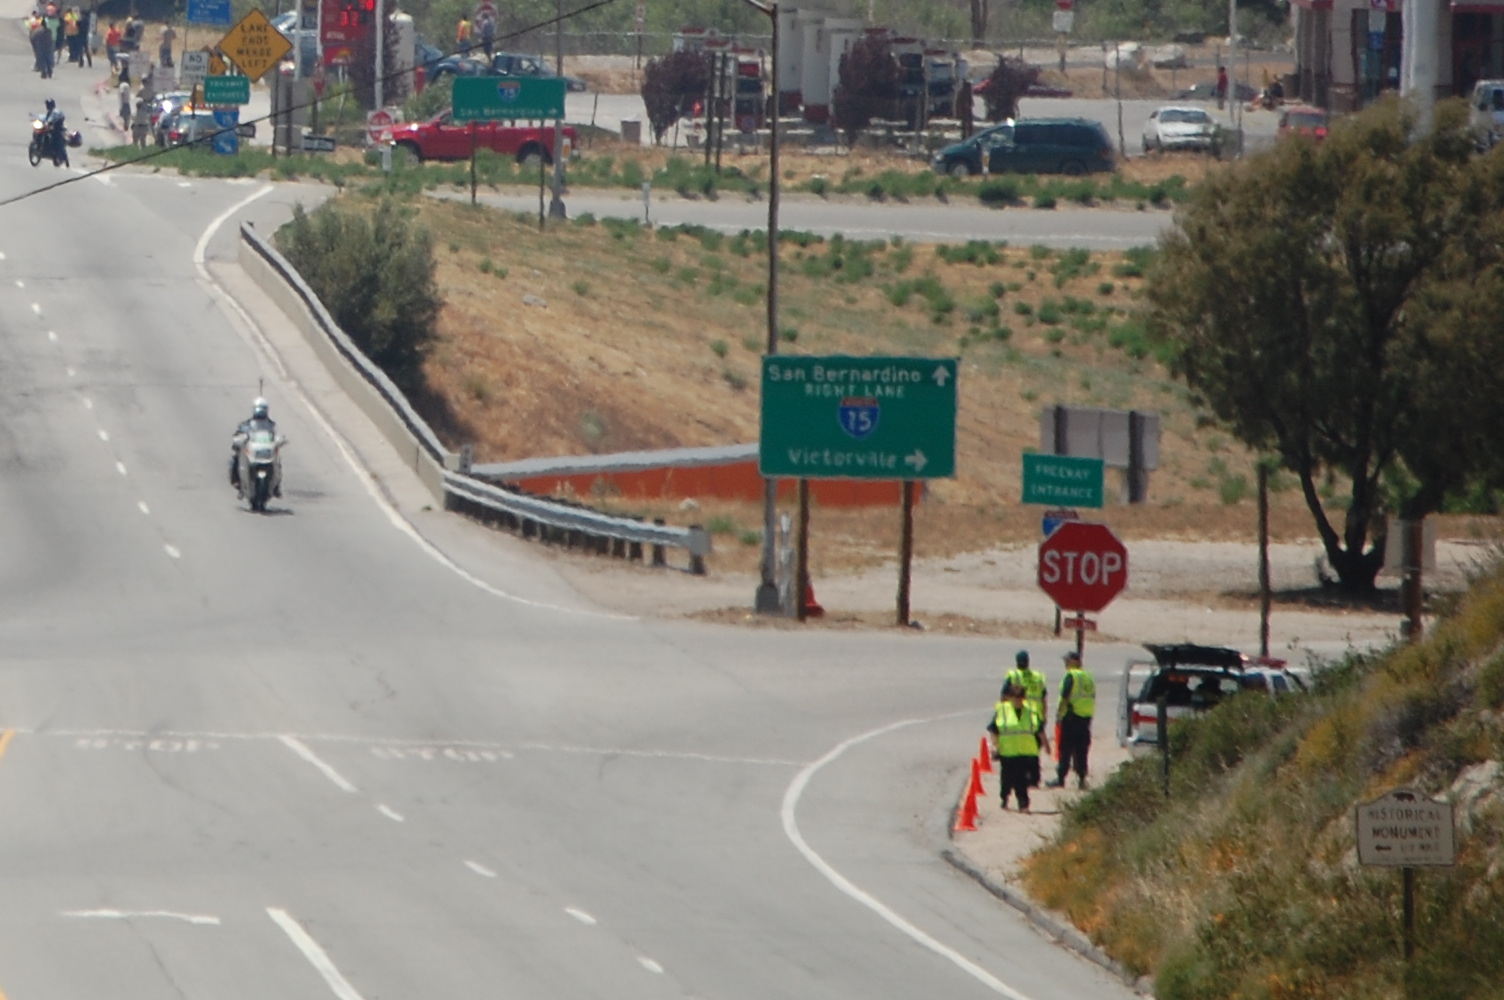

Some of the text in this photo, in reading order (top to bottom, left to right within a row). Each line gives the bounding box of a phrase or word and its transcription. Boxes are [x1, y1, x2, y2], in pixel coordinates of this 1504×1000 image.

[241, 23, 268, 33] LANE
[241, 35, 268, 44] ENDS
[236, 48, 272, 57] MERGE
[242, 59, 268, 68] LEFT
[768, 363, 921, 383] San Bernardino
[804, 383, 905, 398] RIGHT LANE
[848, 410, 872, 432] 15
[787, 448, 897, 469] Victorville
[1035, 465, 1091, 481] FREEWAY
[1030, 483, 1094, 499] ENTRANCE
[1042, 549, 1122, 586] STOP
[1368, 807, 1441, 821] HISTORICAL
[1371, 826, 1441, 840] MONUMENT
